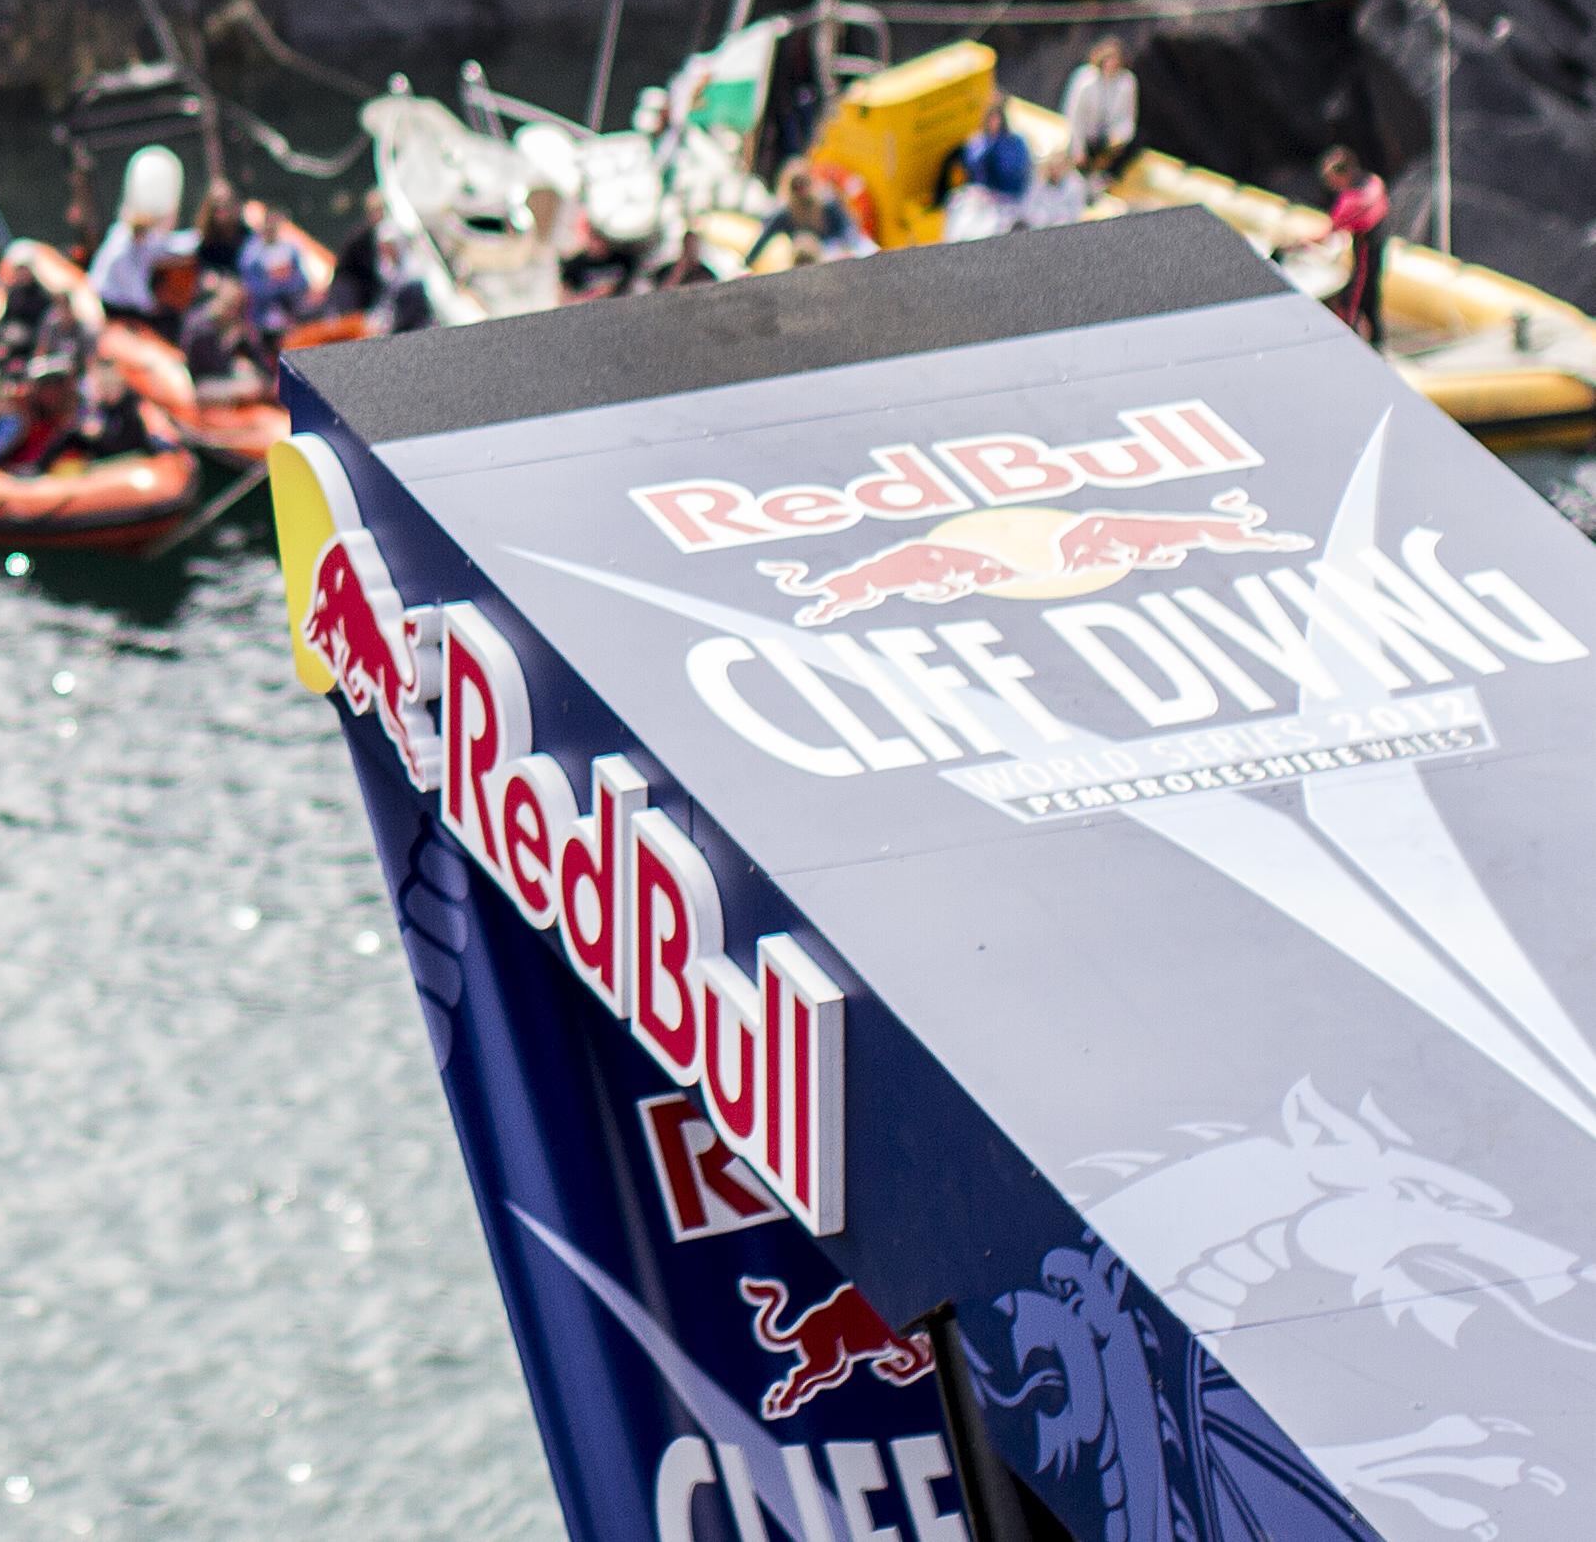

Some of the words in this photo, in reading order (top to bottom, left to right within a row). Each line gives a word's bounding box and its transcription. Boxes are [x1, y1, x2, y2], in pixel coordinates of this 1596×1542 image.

[634, 445, 966, 550] Red
[942, 401, 1260, 502] Bull
[686, 618, 1074, 777] CLIFF
[1042, 526, 1588, 728] DIVING
[964, 745, 1139, 795] WORLD
[1151, 720, 1319, 767] SERIES
[1328, 692, 1480, 740] 2012
[1024, 746, 1364, 815] PEMBROKESHIRE
[1368, 728, 1476, 760] WALES
[442, 606, 642, 1018] Red
[634, 812, 834, 1232] Bull
